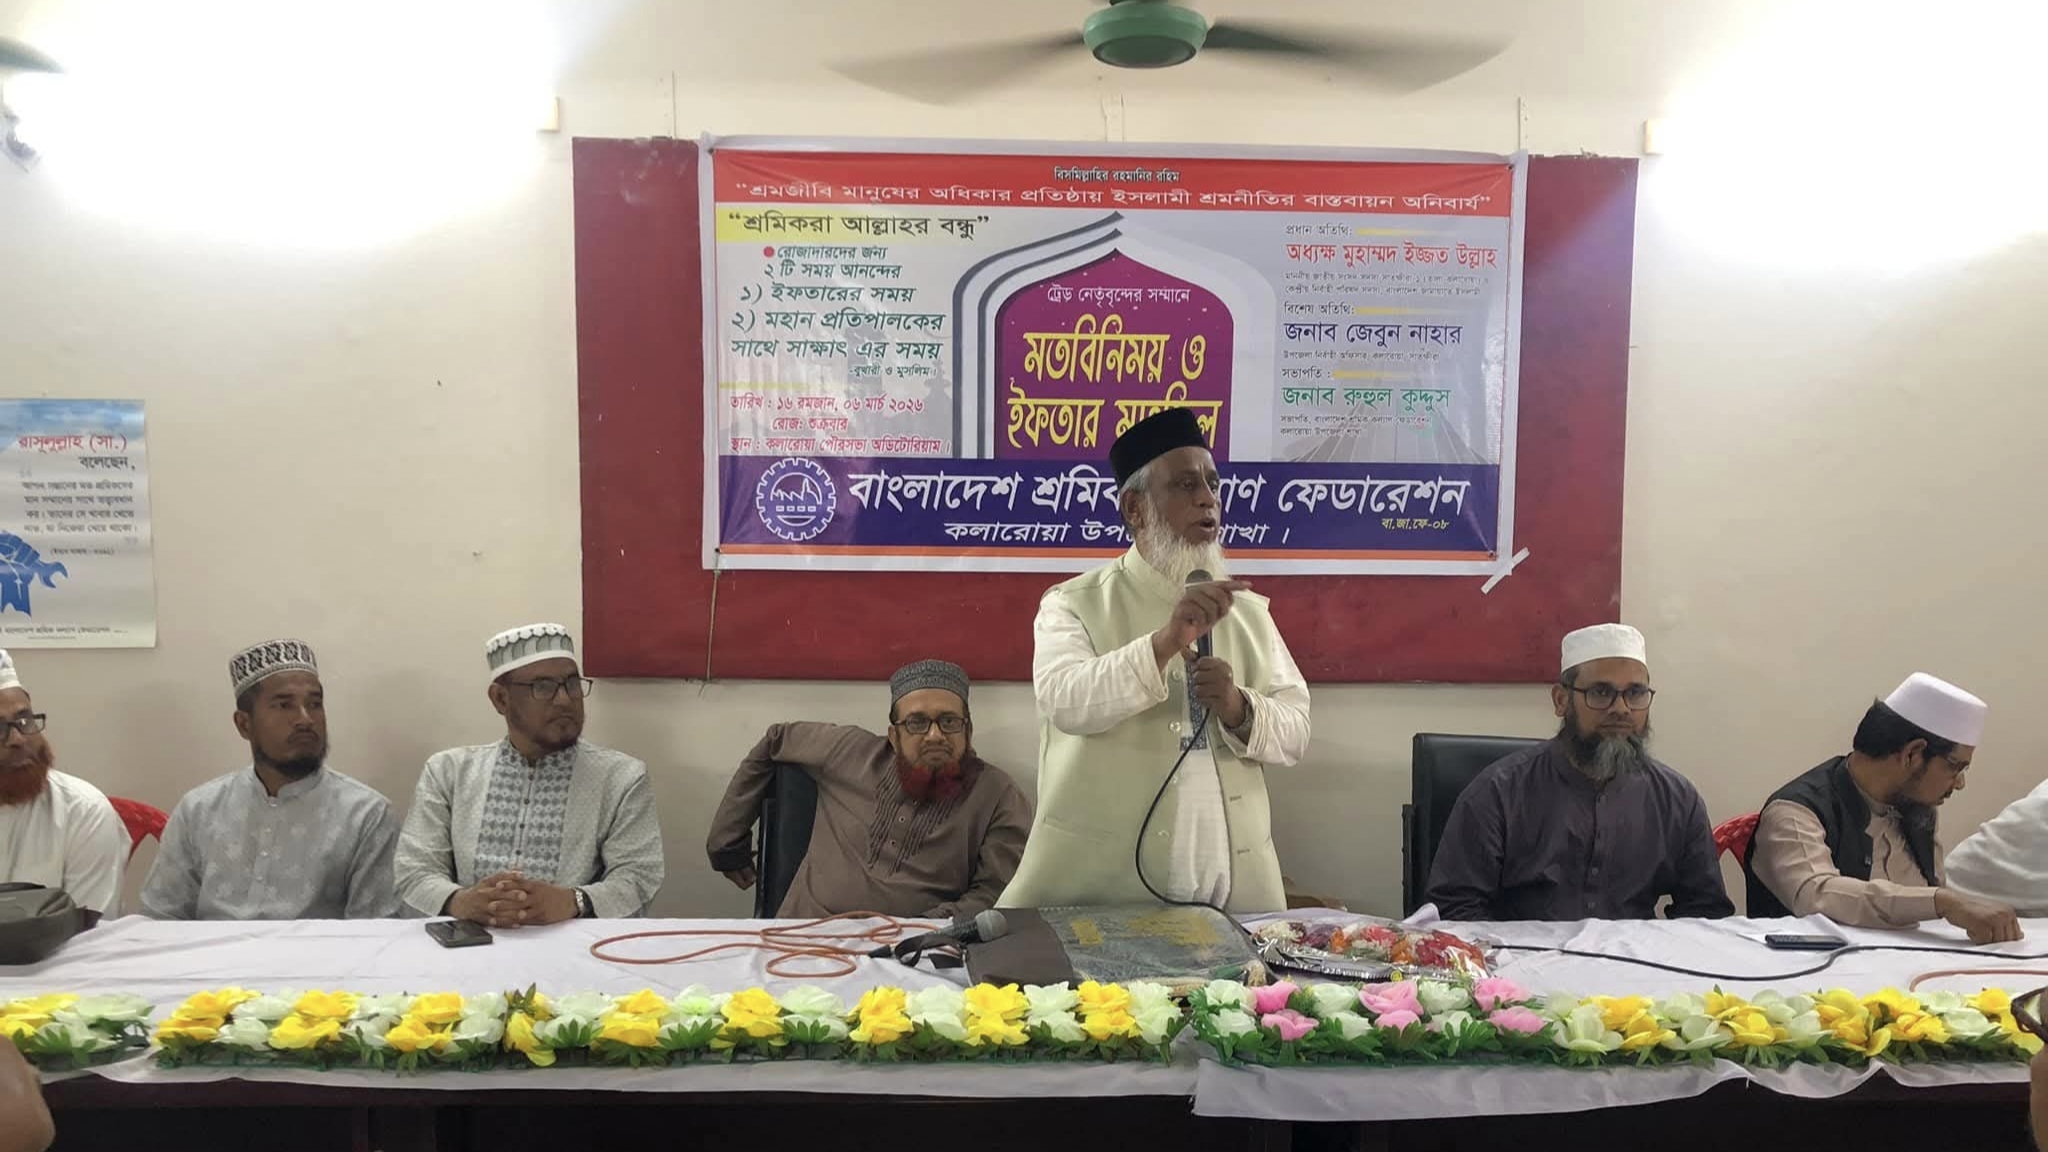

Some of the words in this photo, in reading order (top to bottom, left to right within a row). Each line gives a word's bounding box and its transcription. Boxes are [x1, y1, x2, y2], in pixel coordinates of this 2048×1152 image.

[1054, 166, 1108, 182] বিসমিল্লাহির
[1112, 167, 1152, 183] রহমানির
[1156, 168, 1180, 183] রহিম
[842, 186, 918, 203] মানুষের
[929, 185, 1012, 201] অধিকার
[1020, 187, 1104, 203] প্রতিষ্ঠায়
[1111, 188, 1192, 205] ইসলামী
[1200, 189, 1294, 207] শ্রমনীতির
[1304, 192, 1395, 208] বাস্তবায়ন
[841, 215, 931, 237] আল্লাহর
[1286, 224, 1312, 237] প্রধান
[777, 246, 856, 260] রোজাদারদের
[861, 246, 888, 260] জন্য
[1286, 243, 1337, 263] অধ্যক্ষ
[1343, 244, 1398, 268] মুহাম্মদ
[1403, 240, 1450, 266] ইজ্জত
[1456, 242, 1498, 269] উল্লাহ
[764, 263, 774, 279] ২
[780, 258, 796, 278] টি
[802, 263, 836, 279] সময়
[840, 264, 903, 279] আনন্দের
[740, 283, 762, 304] ১)
[770, 281, 864, 302] ইফতারের
[870, 287, 916, 303] সময়
[1047, 283, 1073, 303] ট্রেড
[1078, 287, 1142, 308] নেতৃবৃন্দের
[1148, 287, 1191, 303] সম্মানে
[1284, 301, 1314, 314] বিশেষ
[731, 309, 755, 334] ২)
[765, 311, 816, 331] মহান
[820, 306, 946, 331] প্রতিপালকের
[1284, 321, 1338, 343] জনাব
[1347, 323, 1402, 348] জেবুন
[1408, 324, 1463, 345] নাহার
[731, 340, 780, 358] সাথে
[787, 340, 848, 359] সাক্ষাৎ
[856, 340, 890, 359] এর
[895, 342, 944, 360] সময়
[1023, 313, 1171, 383] মতবিনিময়
[1181, 335, 1206, 381] ও
[885, 366, 893, 376] ও
[1282, 366, 1322, 378] সভাপতি
[730, 393, 765, 410] তারিখ
[777, 399, 793, 411] ১৬
[797, 396, 838, 413] রমজান,
[843, 400, 861, 411] ০৬
[865, 394, 885, 411] মার্চ
[889, 399, 924, 411] ২০২৬
[1281, 385, 1336, 407] জনাব
[1343, 387, 1394, 410] রুহুল
[1400, 388, 1452, 412] কুদ্দুস
[1007, 377, 1105, 449] ইফতার
[808, 417, 849, 432] শুক্রবার
[730, 436, 752, 451] স্থান
[766, 437, 816, 452] কলারোয়া
[819, 433, 868, 452] পৌরসভা
[871, 436, 943, 453] অডিটোরিয়াম
[848, 468, 1023, 512] বাংলাদেশ
[1277, 474, 1471, 515] ফেডারেশন
[944, 521, 1071, 543] কলারোয়া
